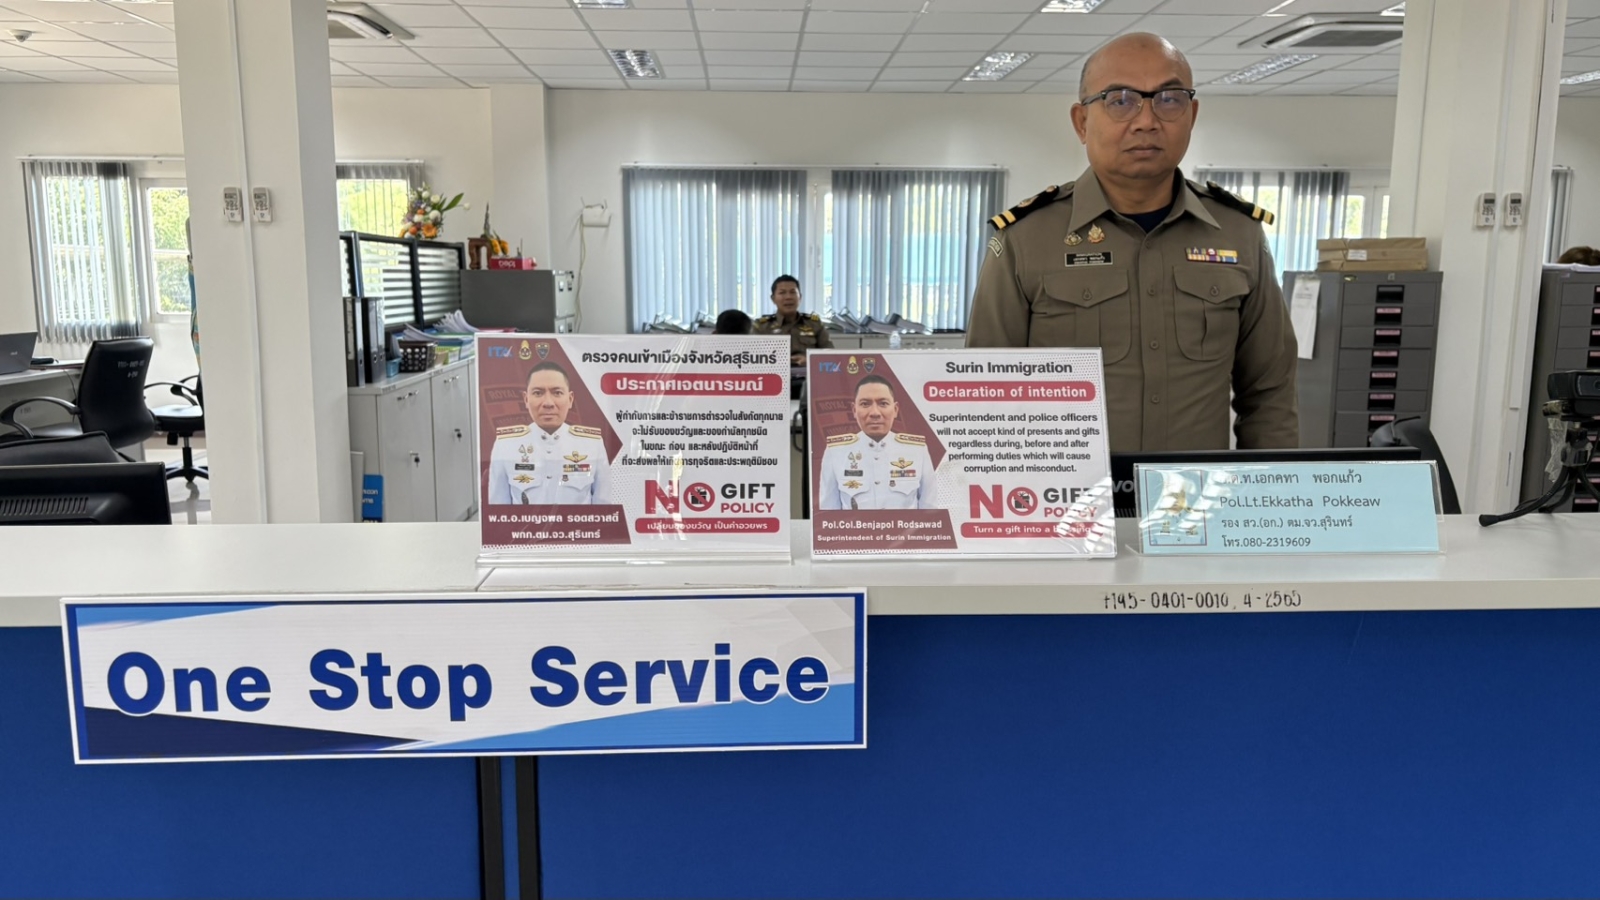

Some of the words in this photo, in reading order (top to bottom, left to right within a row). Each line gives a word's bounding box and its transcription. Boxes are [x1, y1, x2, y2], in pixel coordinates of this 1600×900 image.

[582, 349, 777, 369] ตรวจคนเข้าเมืองจังหวัดสุรินทร์
[945, 361, 983, 373] Surin
[987, 361, 1073, 376] Immigration
[616, 377, 763, 391] ประกาศเจตนารมณ์
[929, 385, 1004, 398] Declaration
[1010, 385, 1024, 398] of
[1028, 385, 1087, 398] intention
[929, 413, 1005, 424] Superintendent
[1008, 413, 1026, 421] and
[1028, 413, 1058, 423] police
[1061, 413, 1098, 421] officers
[936, 427, 951, 435] will
[968, 428, 996, 437] accept
[998, 427, 1015, 435] kind
[1017, 427, 1026, 435] of
[1027, 428, 1063, 437] presents
[1064, 427, 1080, 435] and
[1081, 427, 1100, 437] gifts
[668, 441, 685, 451] ก่อน
[948, 440, 992, 449] regardless
[994, 440, 1023, 449] during,
[1024, 440, 1051, 448] before
[1053, 440, 1068, 448] and
[1070, 440, 1089, 448] after
[948, 452, 994, 462] performing
[996, 452, 1021, 460] duties
[1023, 452, 1048, 460] which
[1050, 452, 1064, 460] will
[963, 464, 1007, 474] corruption
[1008, 464, 1024, 472] and
[1026, 464, 1077, 472] misconduct.
[1312, 469, 1362, 484] พอกแก้ว
[720, 483, 775, 499] GIFT
[720, 502, 775, 513] POLICY
[1220, 496, 1313, 508] Pol.Lt.Ekkatha
[1322, 496, 1381, 507] Pokkeaw
[714, 520, 768, 530] เป็นคำอวยพร
[822, 520, 894, 530] Pol.Col.Benjapol
[897, 520, 942, 528] Rodsawad
[1221, 519, 1239, 528] รอง
[1243, 517, 1283, 529] สว.(อก.)
[1287, 515, 1353, 531] ตม.จว.สุรินทร์
[1005, 525, 1020, 535] gift
[1023, 525, 1041, 533] into
[908, 534, 951, 542] Immigration
[1221, 535, 1311, 548] โทร.080-2319609
[107, 651, 271, 715] One
[309, 648, 493, 722] Stop
[529, 643, 829, 708] Service
